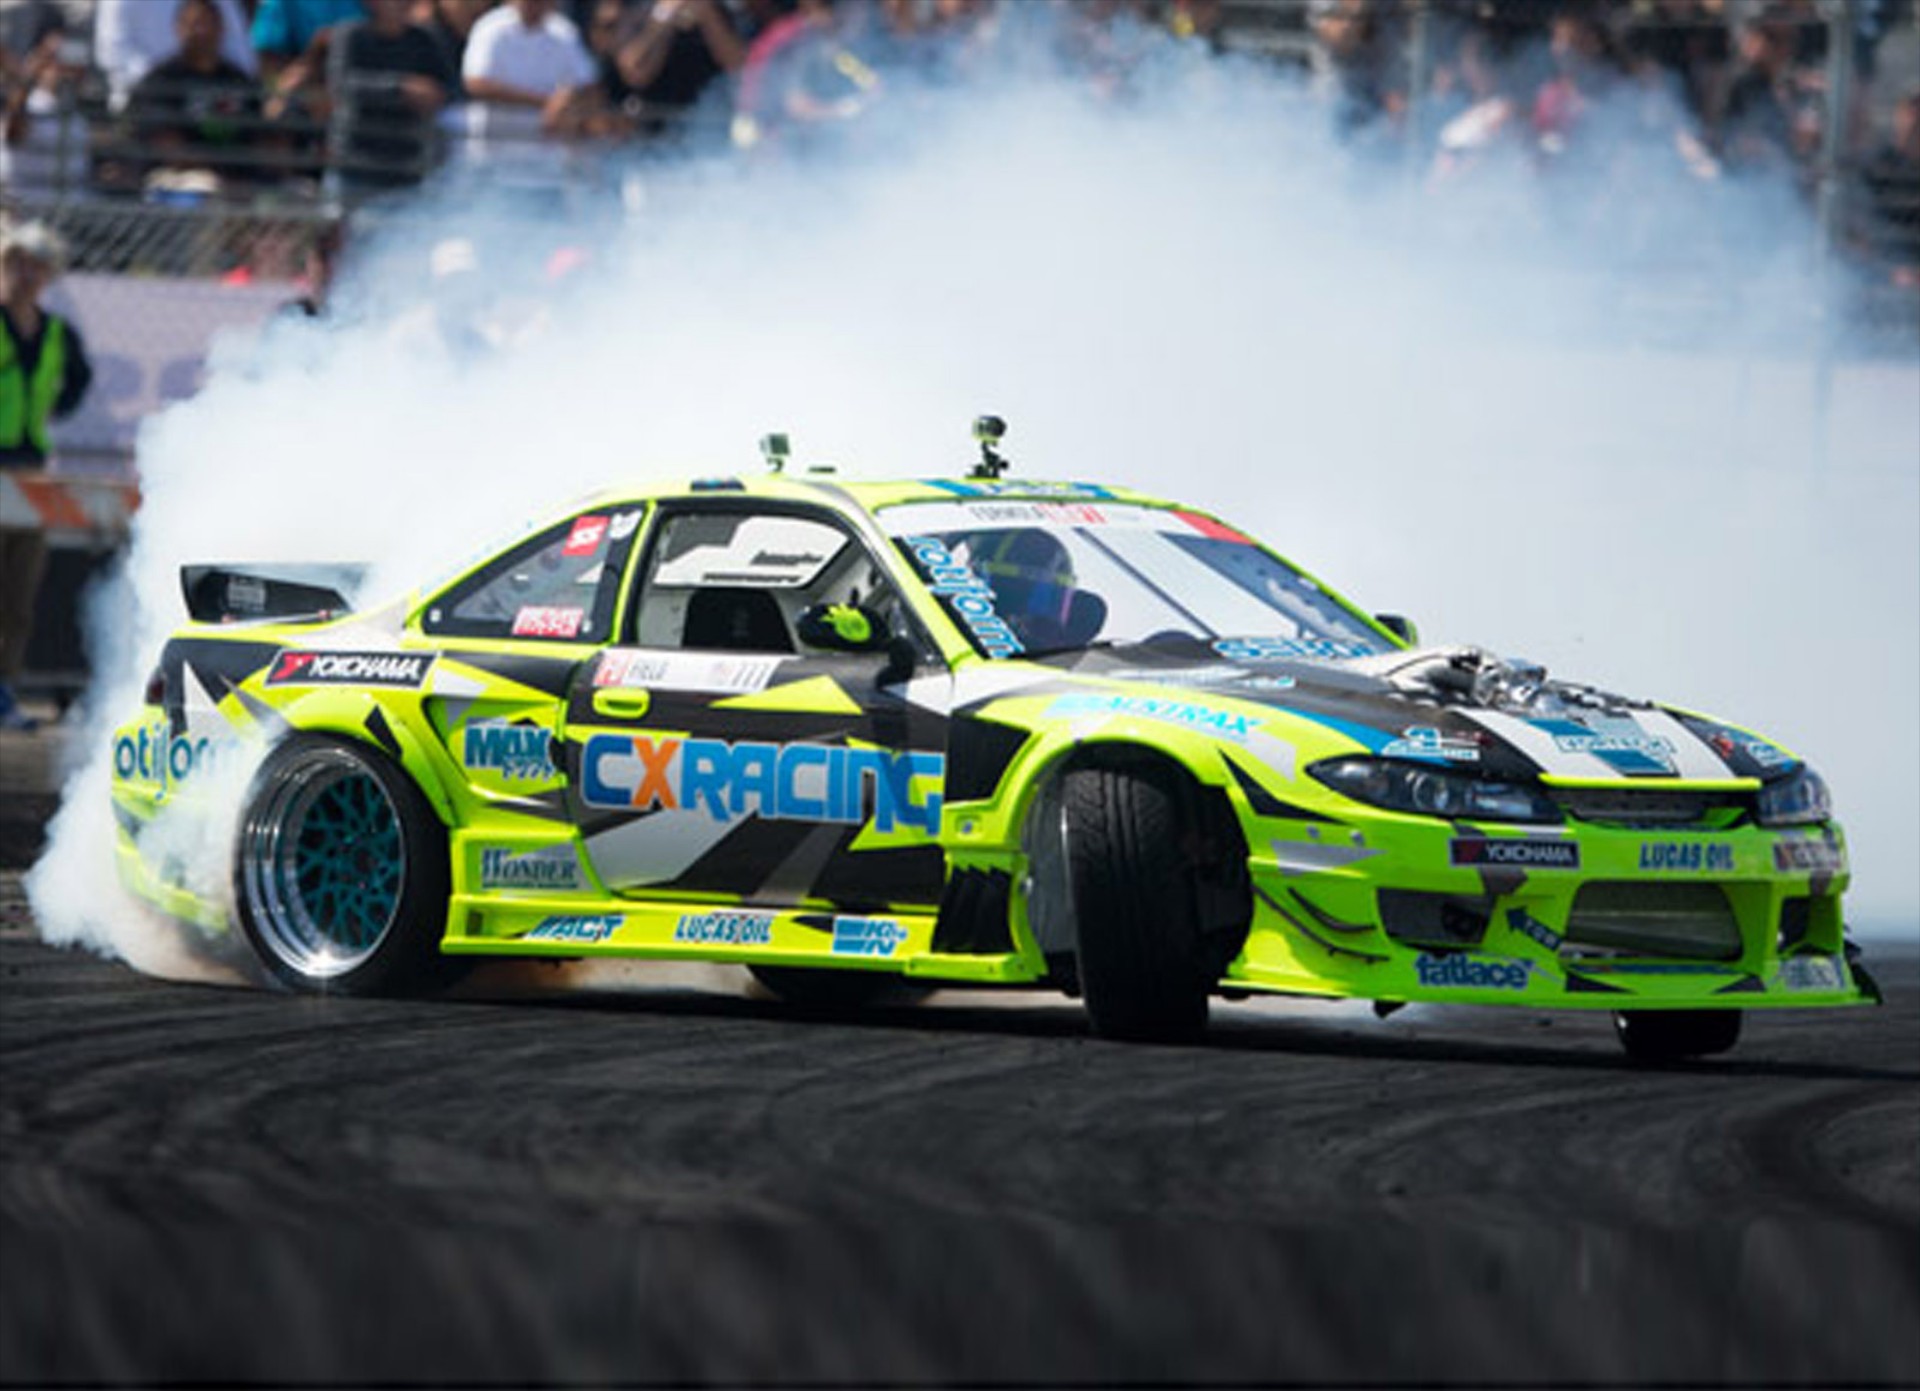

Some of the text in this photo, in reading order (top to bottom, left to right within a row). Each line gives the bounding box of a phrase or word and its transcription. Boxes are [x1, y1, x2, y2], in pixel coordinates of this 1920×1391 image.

[308, 655, 421, 680] YOKOHAMA
[464, 727, 549, 768] MAX
[582, 735, 944, 836] CXRACING
[1486, 844, 1574, 862] YOKOHAMA
[1639, 843, 1734, 870] LUCAS OIL
[675, 914, 772, 943] LUCAS OIL
[1414, 952, 1529, 990] fatlace
